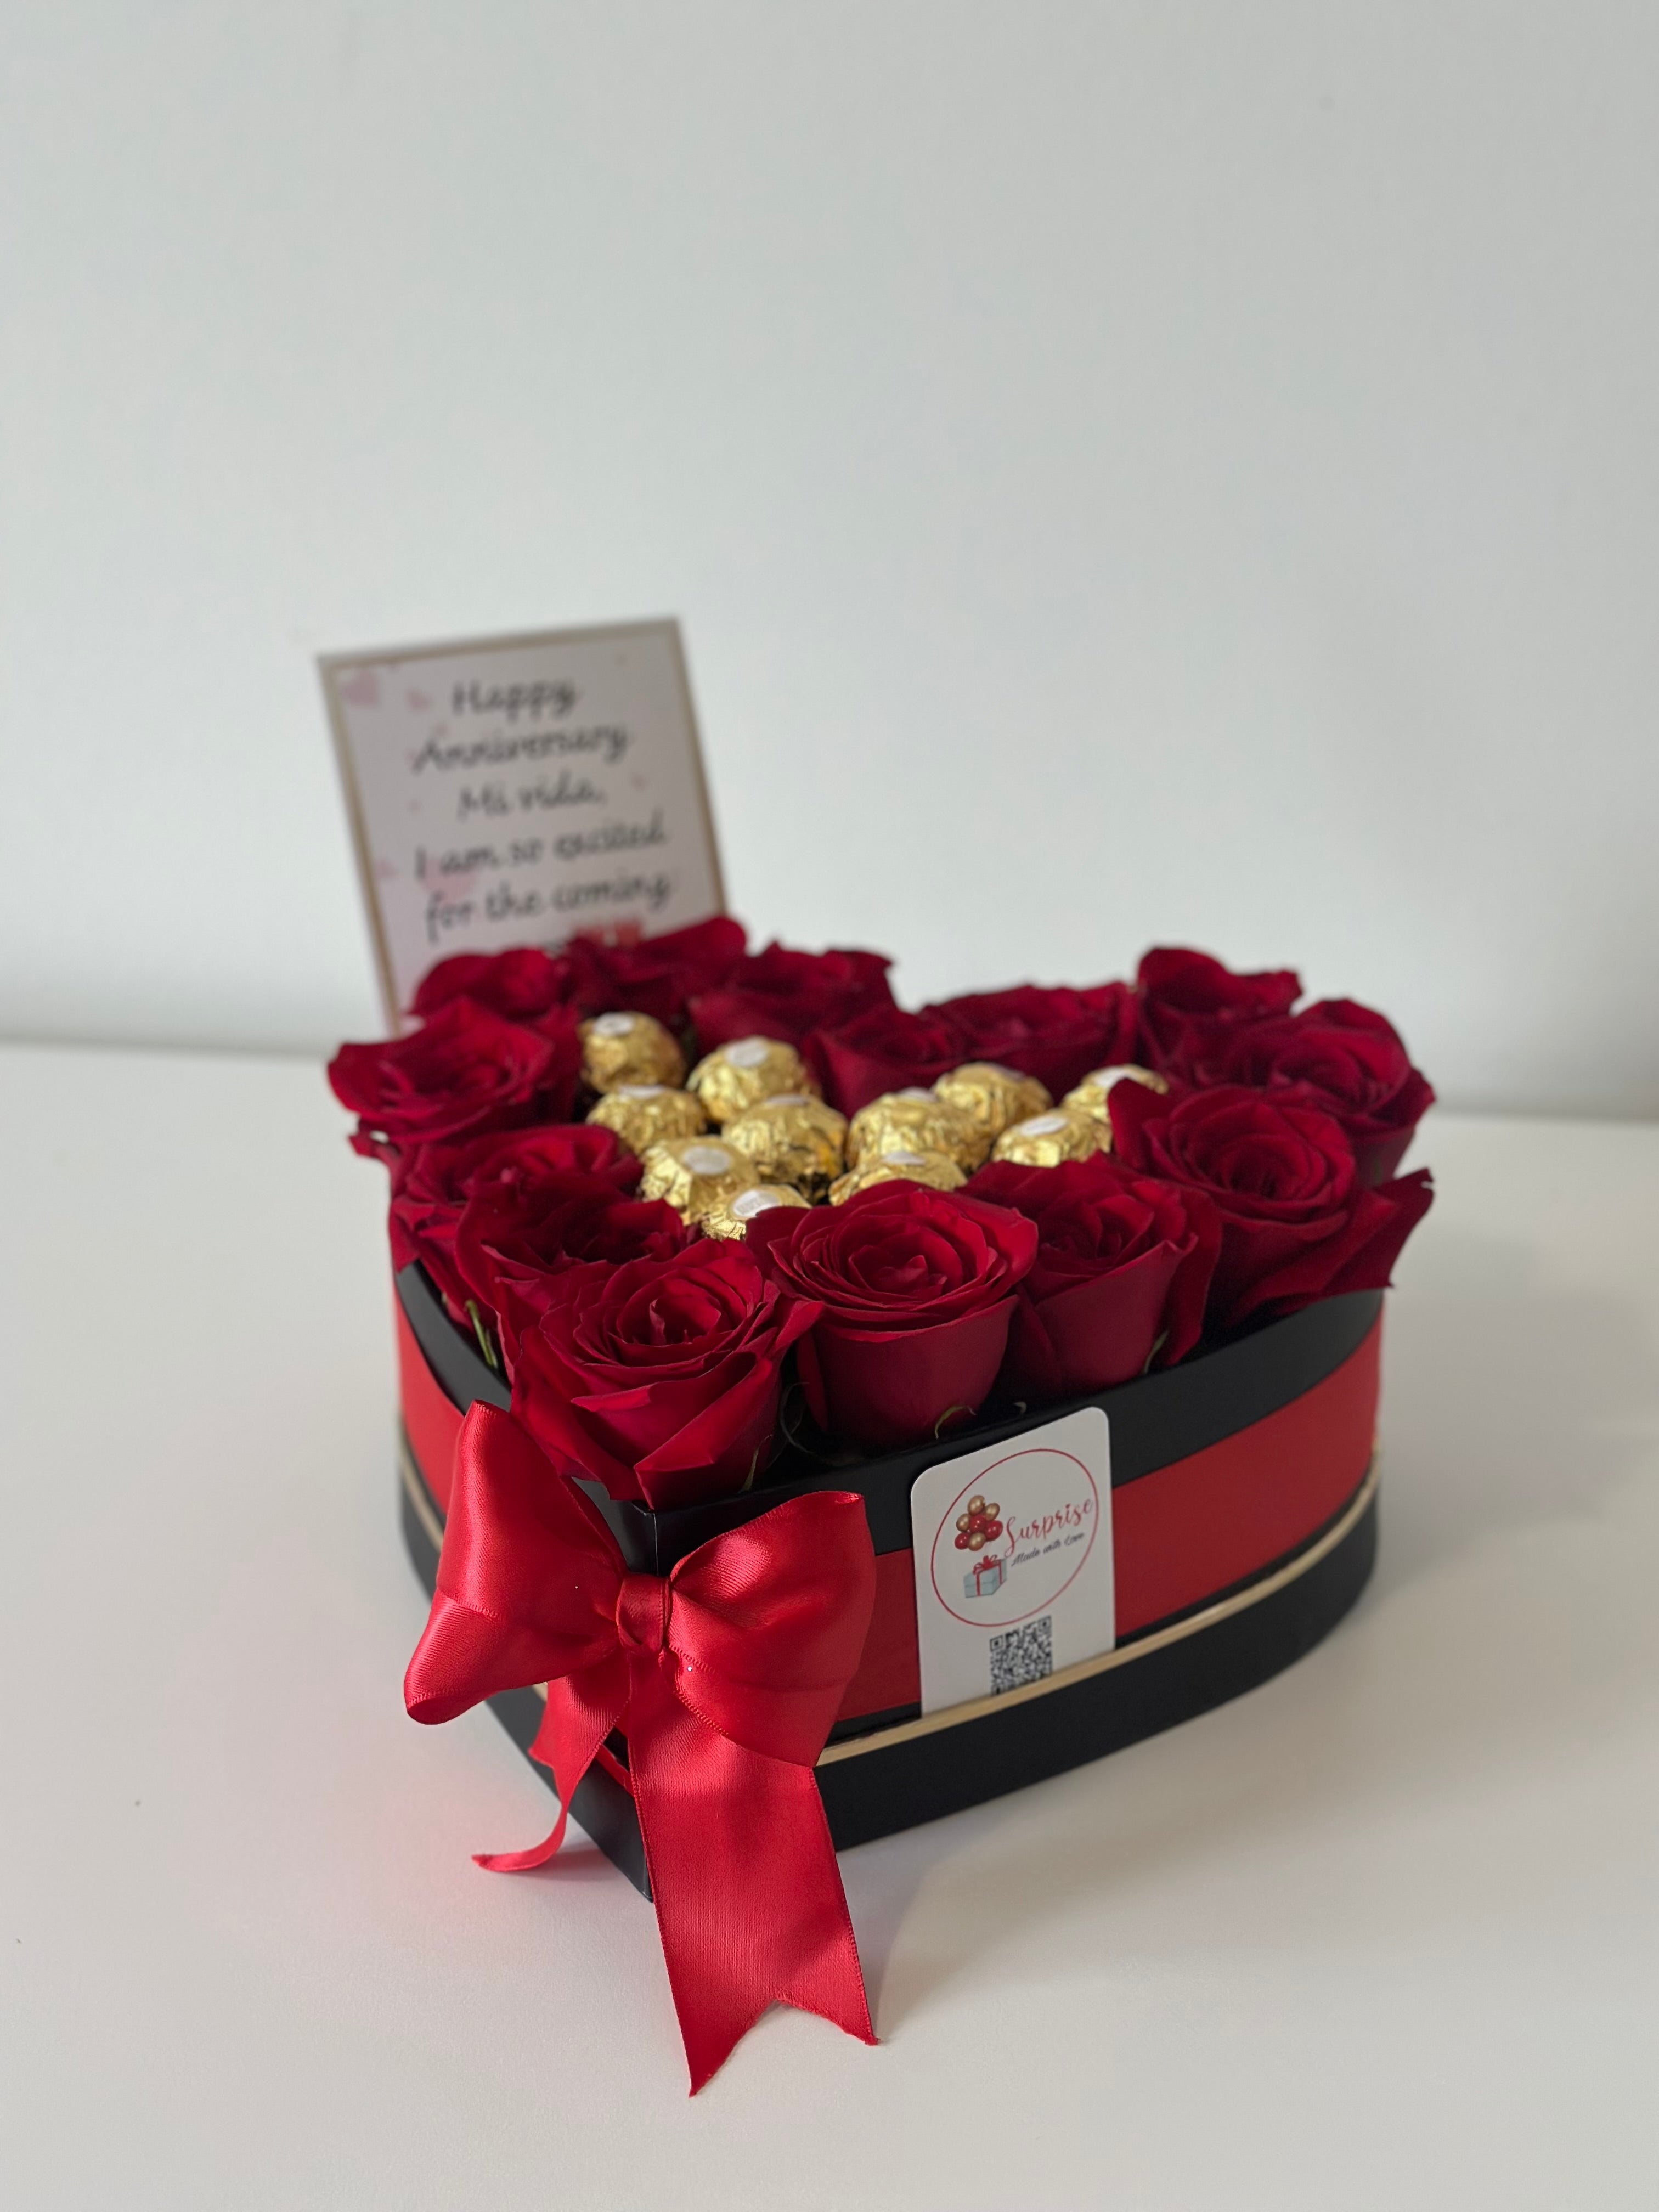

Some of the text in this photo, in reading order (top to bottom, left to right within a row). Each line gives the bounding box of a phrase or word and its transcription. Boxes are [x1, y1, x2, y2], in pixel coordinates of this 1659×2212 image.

[451, 681, 577, 722] Happy
[413, 724, 630, 771] Anniversary
[458, 785, 510, 820] Mi
[414, 806, 667, 879] I am so excited
[426, 873, 670, 943] for the coming
[1004, 1498, 1093, 1558] Surprise
[1011, 1533, 1085, 1567] Made with Love
